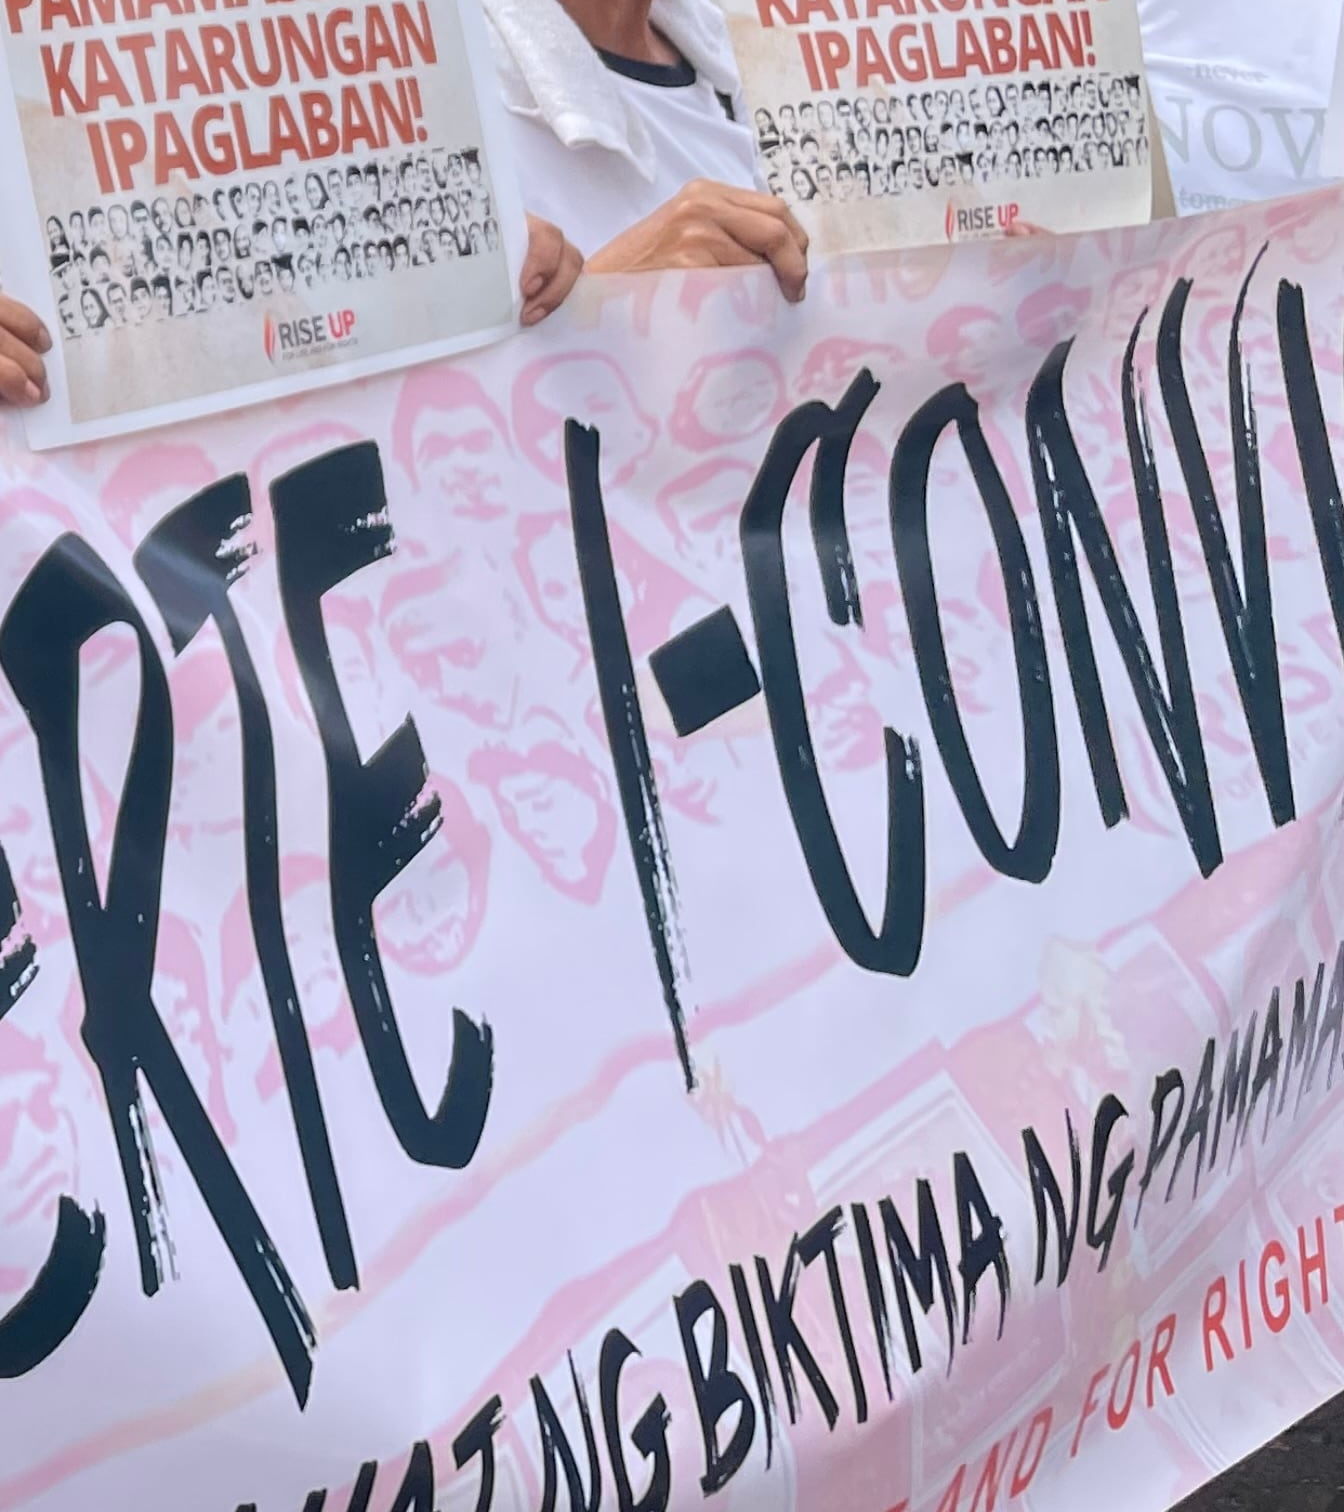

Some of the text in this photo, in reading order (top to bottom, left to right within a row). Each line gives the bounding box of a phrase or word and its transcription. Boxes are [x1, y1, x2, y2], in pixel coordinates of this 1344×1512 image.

[39, 0, 438, 118] KATARUNGAN
[797, 10, 1097, 92] IPAGLABAN!
[86, 77, 429, 195] IPAGLABAN!
[956, 202, 1019, 232] RISE UP
[278, 316, 326, 350] RISE
[327, 309, 357, 340] UP
[563, 241, 1344, 1093] I-CONVI
[529, 1326, 673, 1512] NG
[672, 1151, 1012, 1499] BIKTIMA
[1021, 1092, 1136, 1288] NG
[1133, 939, 1344, 1230] PAMAMA
[1070, 1312, 1177, 1458] FOR
[1201, 1205, 1344, 1373] RIGH
